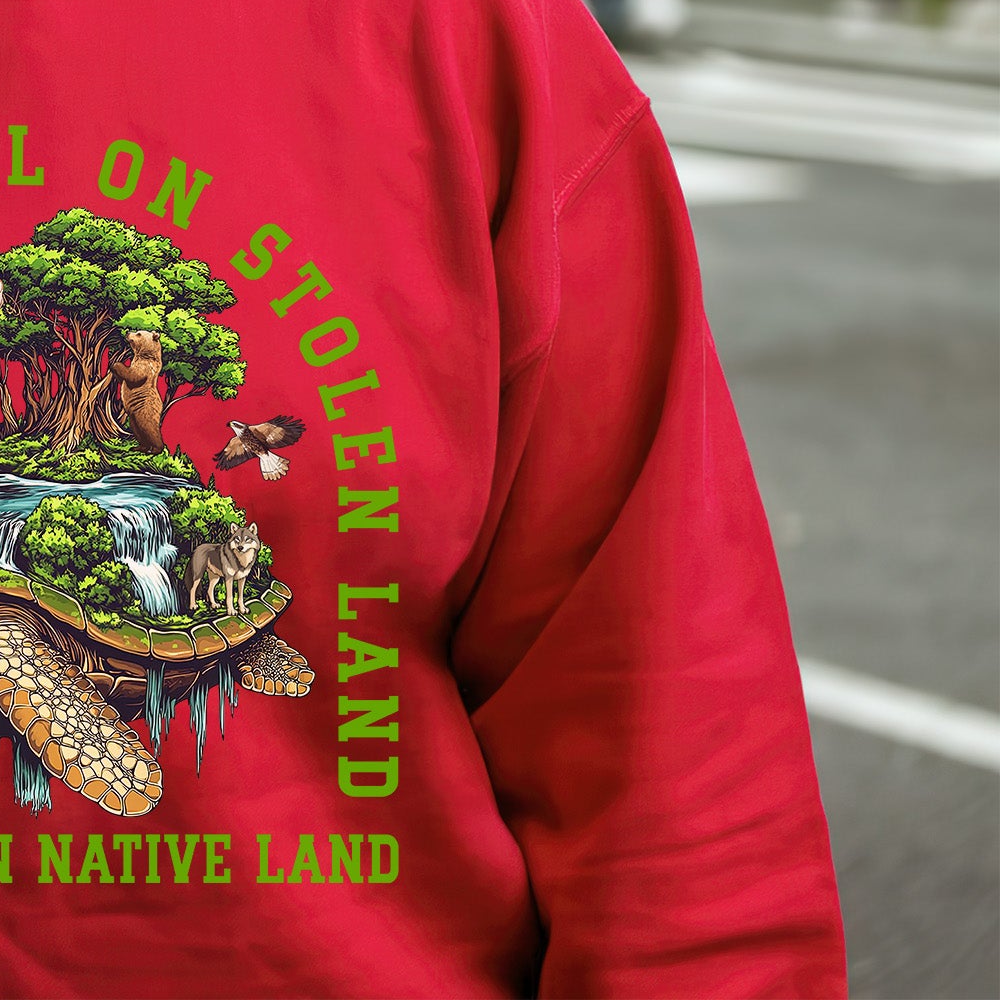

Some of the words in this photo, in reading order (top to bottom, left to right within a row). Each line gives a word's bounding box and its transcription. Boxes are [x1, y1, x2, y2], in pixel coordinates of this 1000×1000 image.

[98, 139, 213, 229] ON
[230, 224, 399, 533] STOLEN
[338, 583, 399, 797] LAND
[38, 834, 231, 883] NATIVE
[257, 834, 399, 883] LAND
